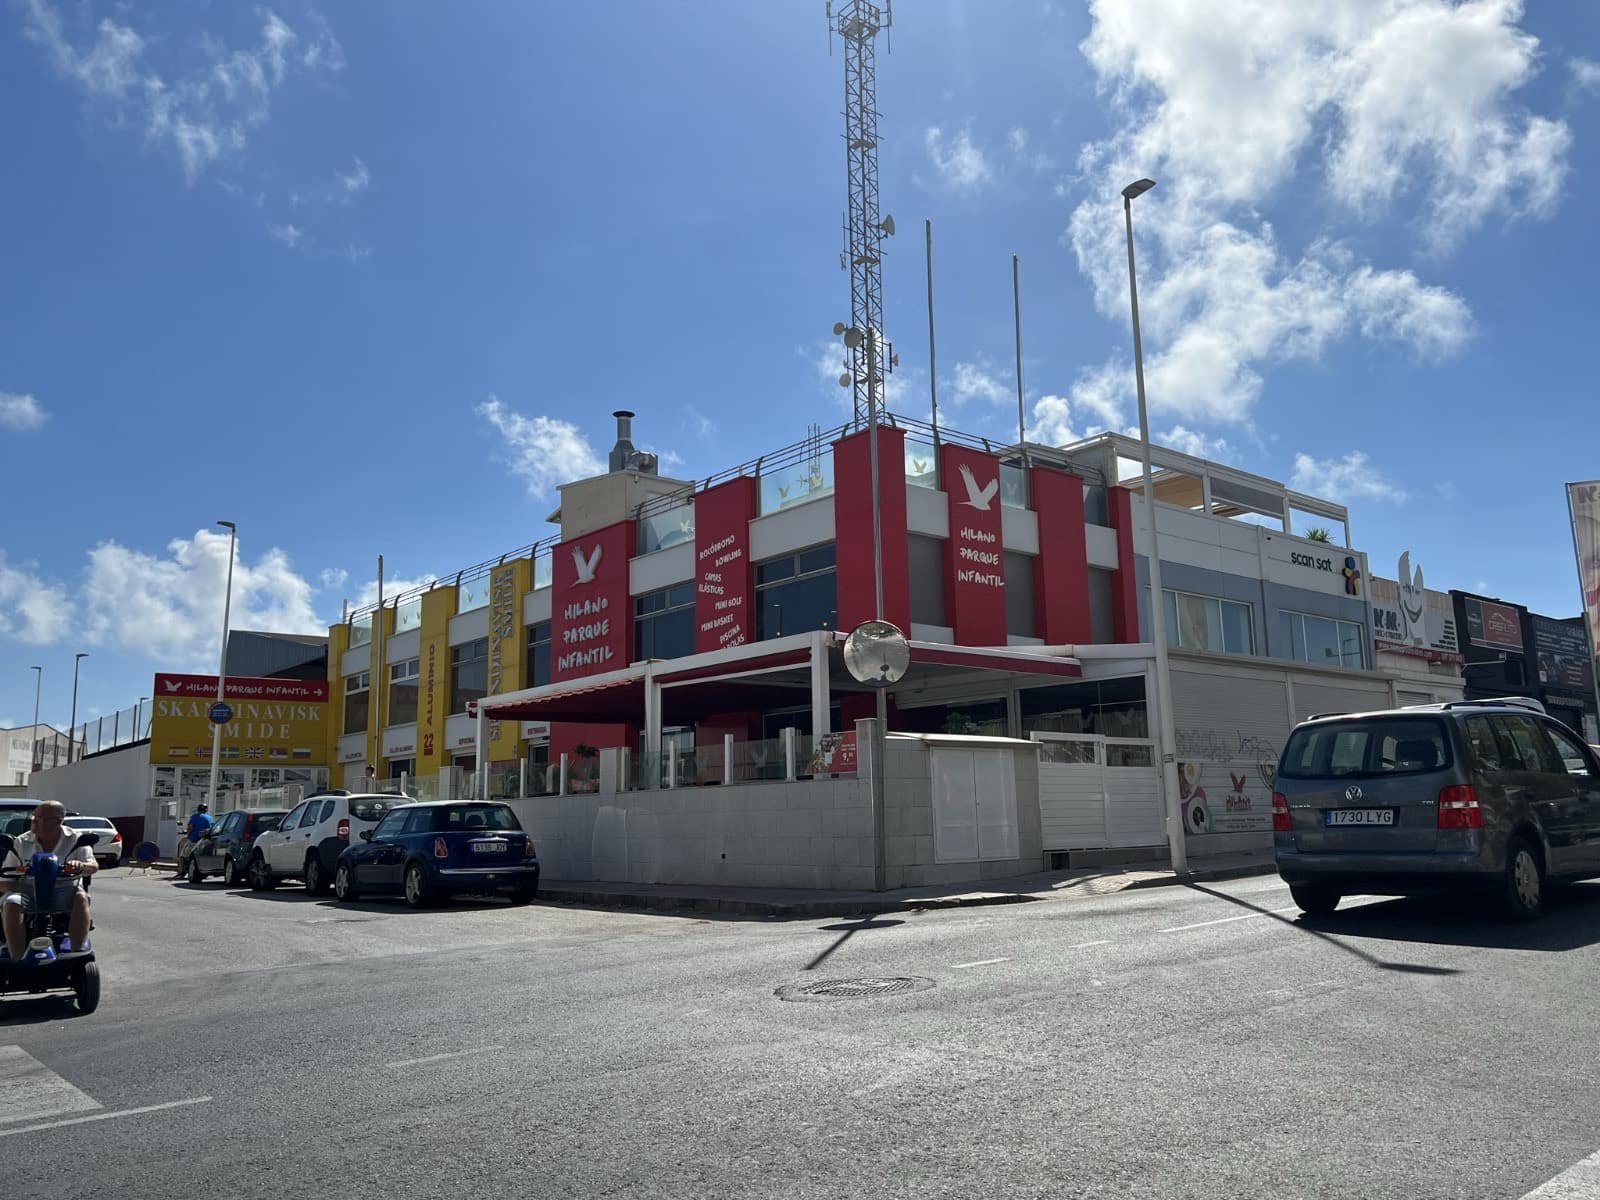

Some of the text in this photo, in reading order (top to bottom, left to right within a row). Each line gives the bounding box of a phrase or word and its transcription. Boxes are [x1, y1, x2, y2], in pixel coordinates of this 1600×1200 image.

[960, 547, 999, 565] PARQUE
[1291, 552, 1333, 572] scan sat
[958, 569, 1005, 588] INFANTIL
[563, 618, 610, 644] PARQUE
[557, 645, 614, 672] INFANTIL
[226, 685, 263, 694] PARQUE
[266, 687, 309, 696] INFANTIL
[427, 643, 435, 726] ALUMINIO
[157, 700, 320, 721] SKAINAVISK
[424, 734, 433, 748] 22
[1333, 811, 1391, 823] 1730 LYG
